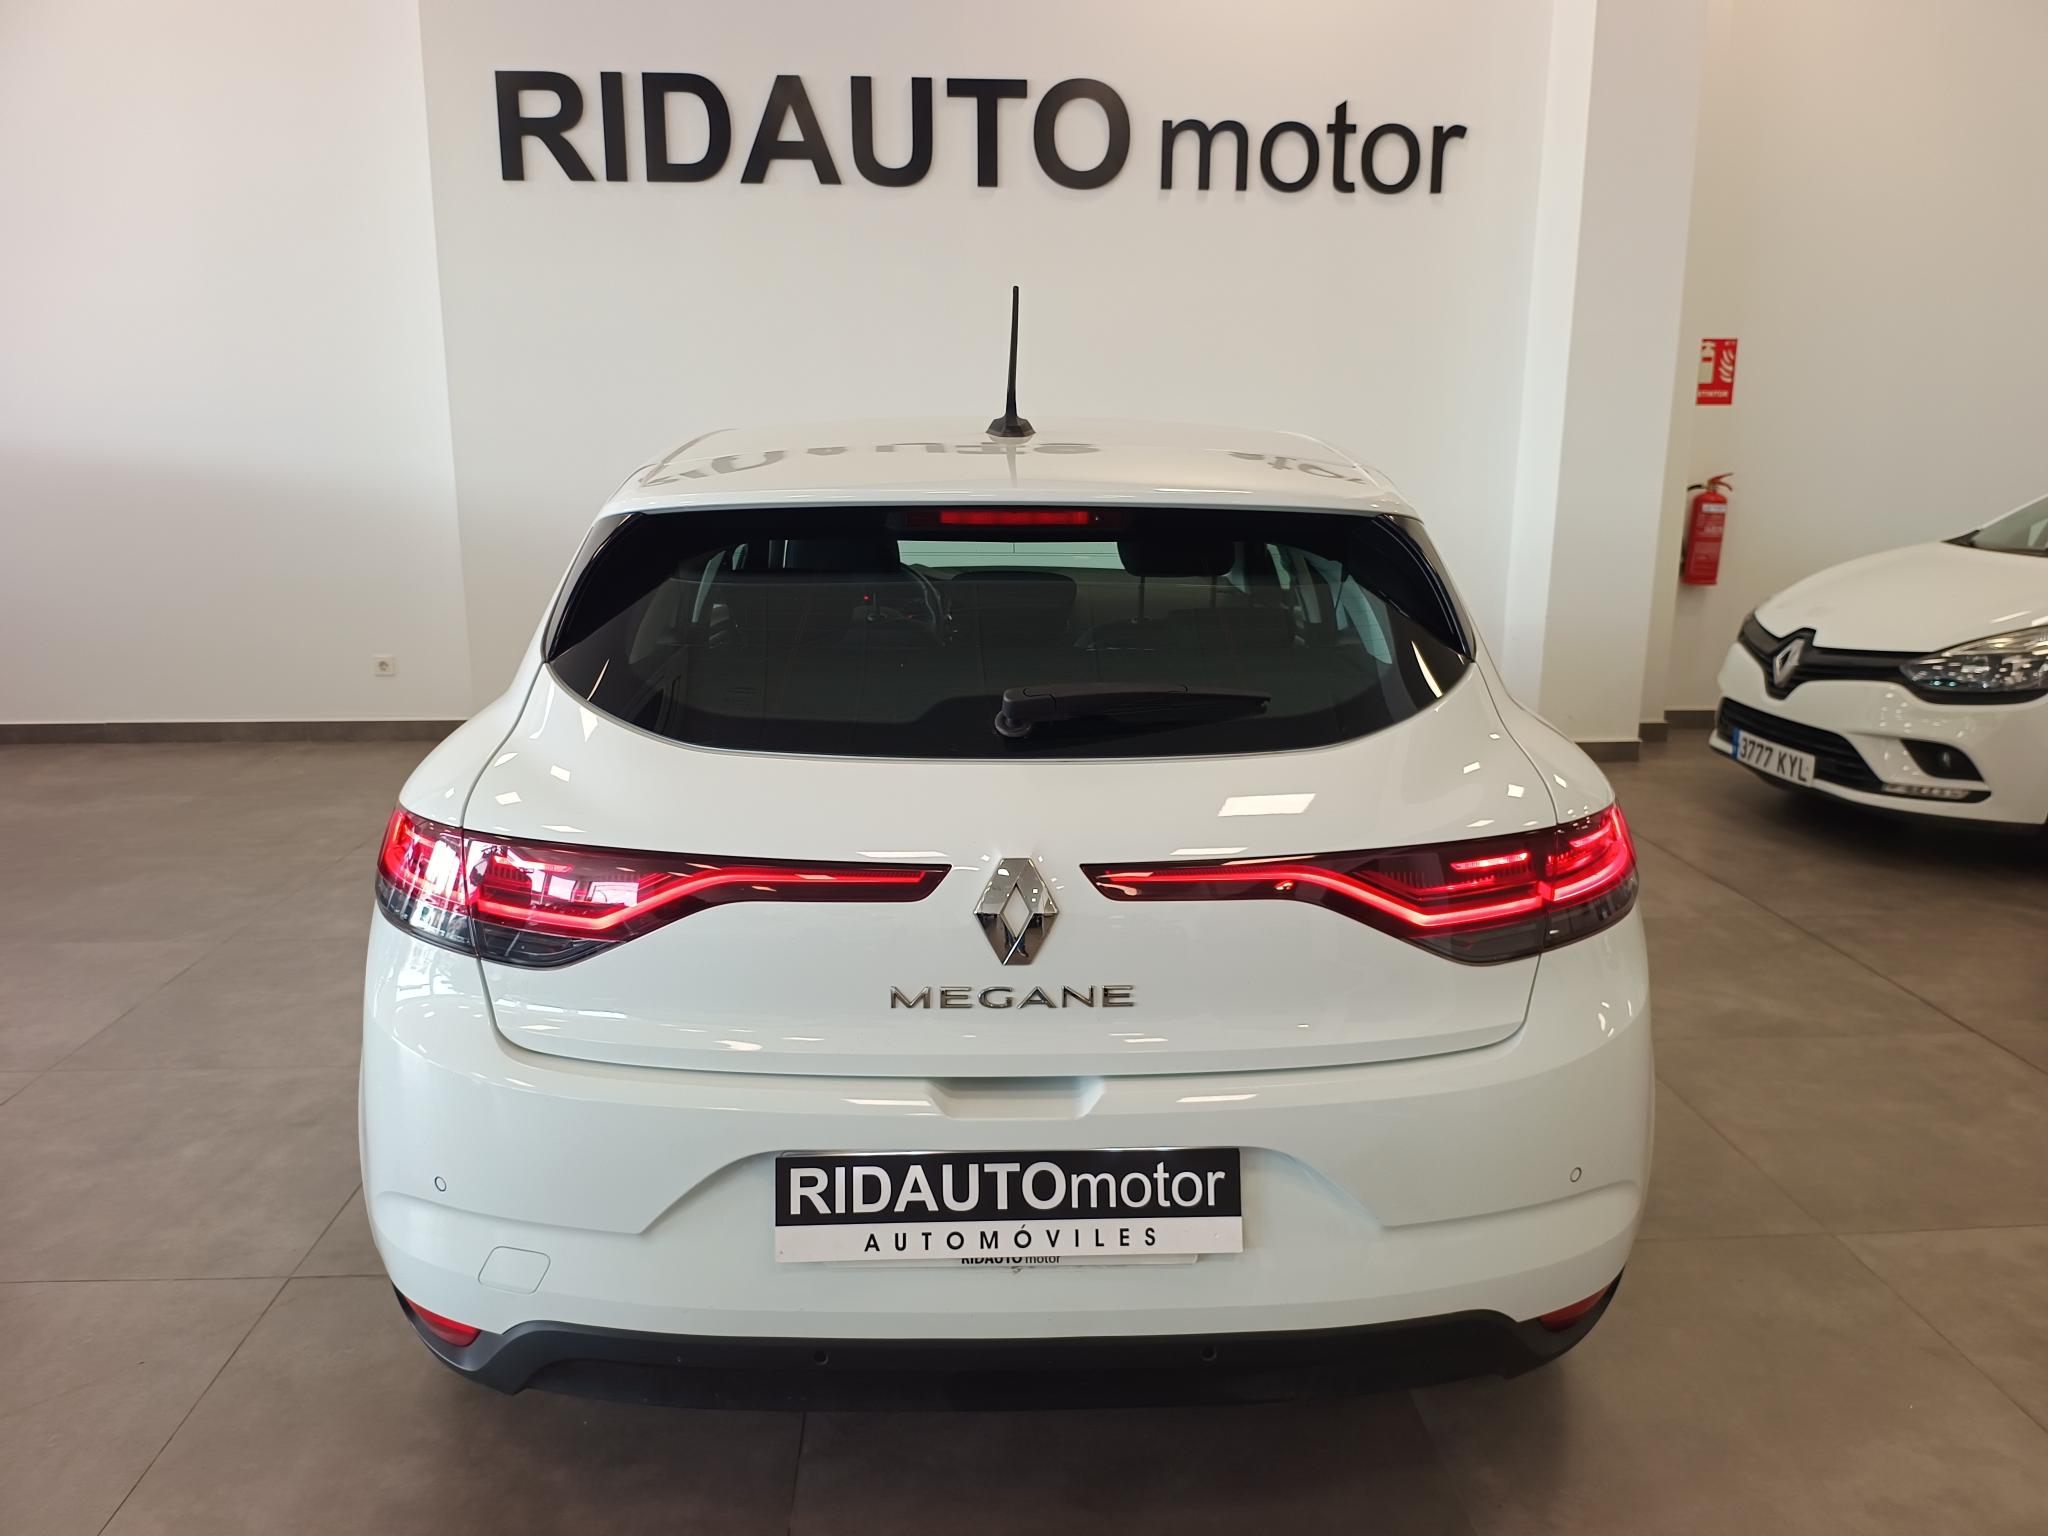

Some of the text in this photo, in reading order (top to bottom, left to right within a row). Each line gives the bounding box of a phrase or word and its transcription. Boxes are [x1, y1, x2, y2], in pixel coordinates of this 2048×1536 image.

[495, 71, 1468, 194] RIDAUTO motor
[1741, 737, 1807, 782] 3777 KYL
[890, 985, 1136, 1010] MEGANE
[864, 1225, 1156, 1252] AUTOMÓVILES
